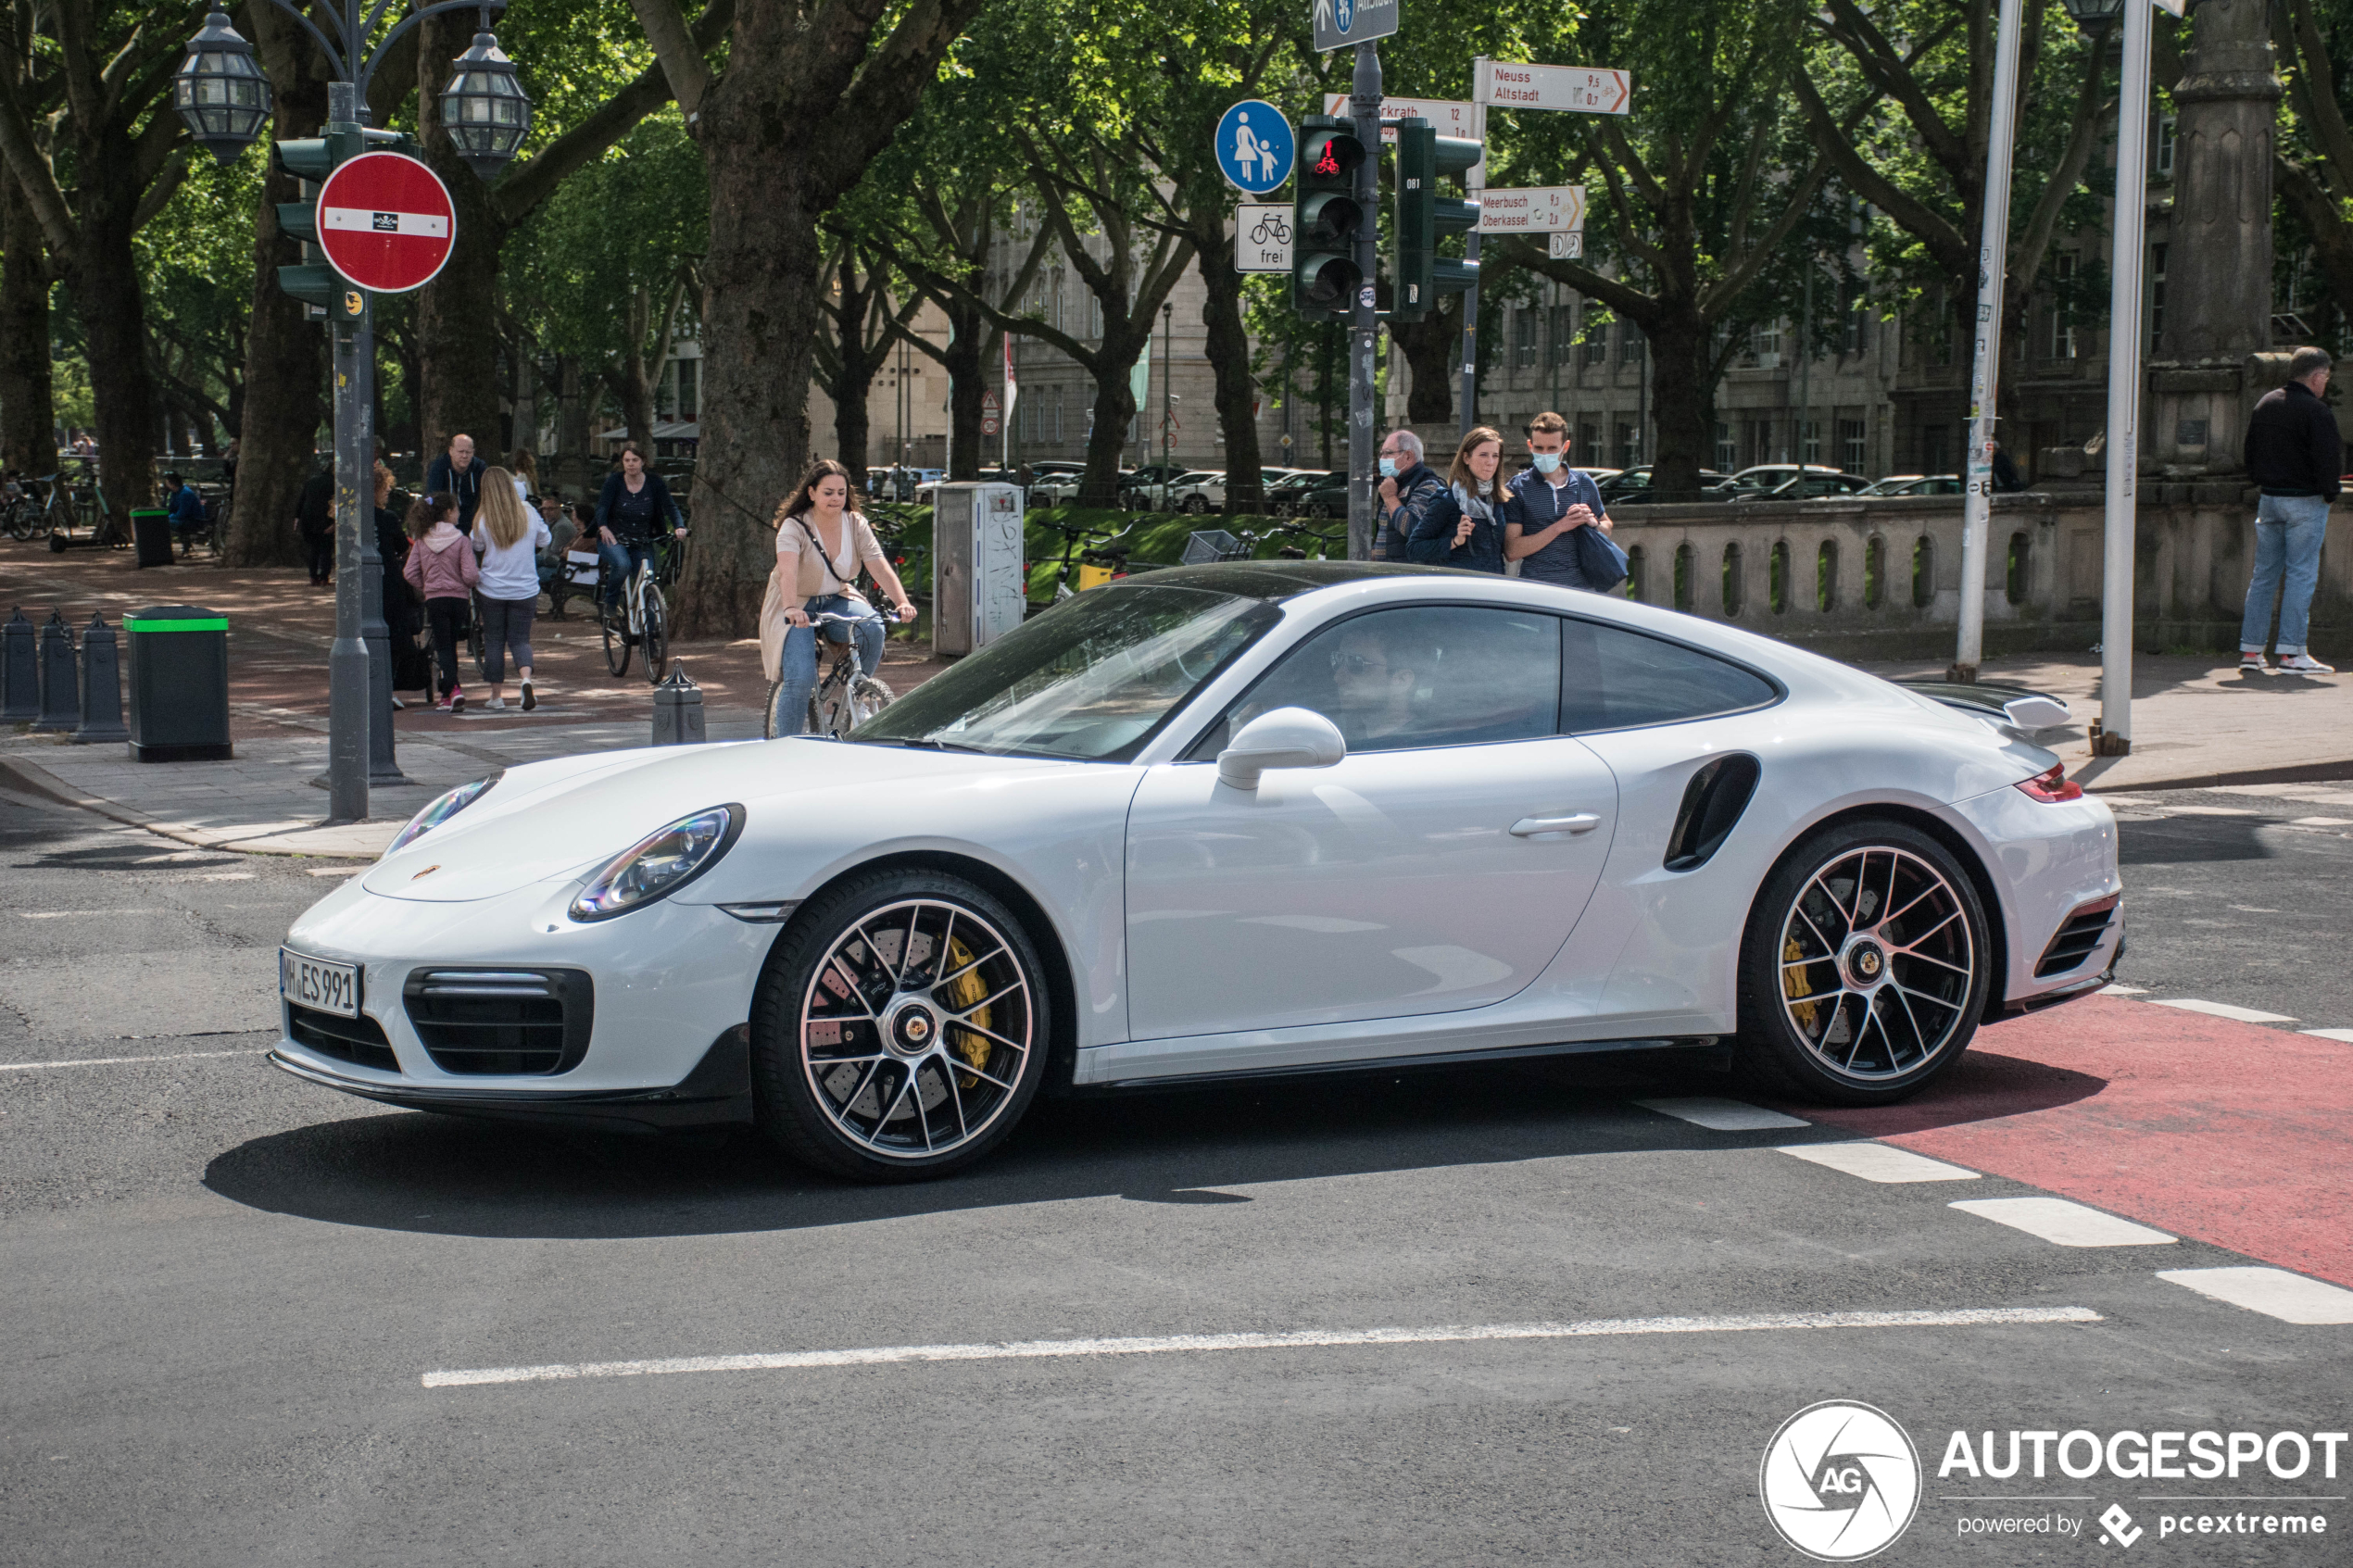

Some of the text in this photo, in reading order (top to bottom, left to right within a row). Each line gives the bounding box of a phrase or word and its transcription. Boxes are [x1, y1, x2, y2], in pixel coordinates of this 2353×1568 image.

[1494, 68, 1600, 88] Neuss 9,5
[1494, 86, 1599, 106] Altstadt 0,7
[1381, 104, 1460, 120] rkrath 12
[1406, 178, 1420, 189] 081
[1483, 194, 1560, 208] Meerbusch 9,3
[1482, 214, 1529, 227] Oberkassel
[1261, 248, 1283, 264] frei
